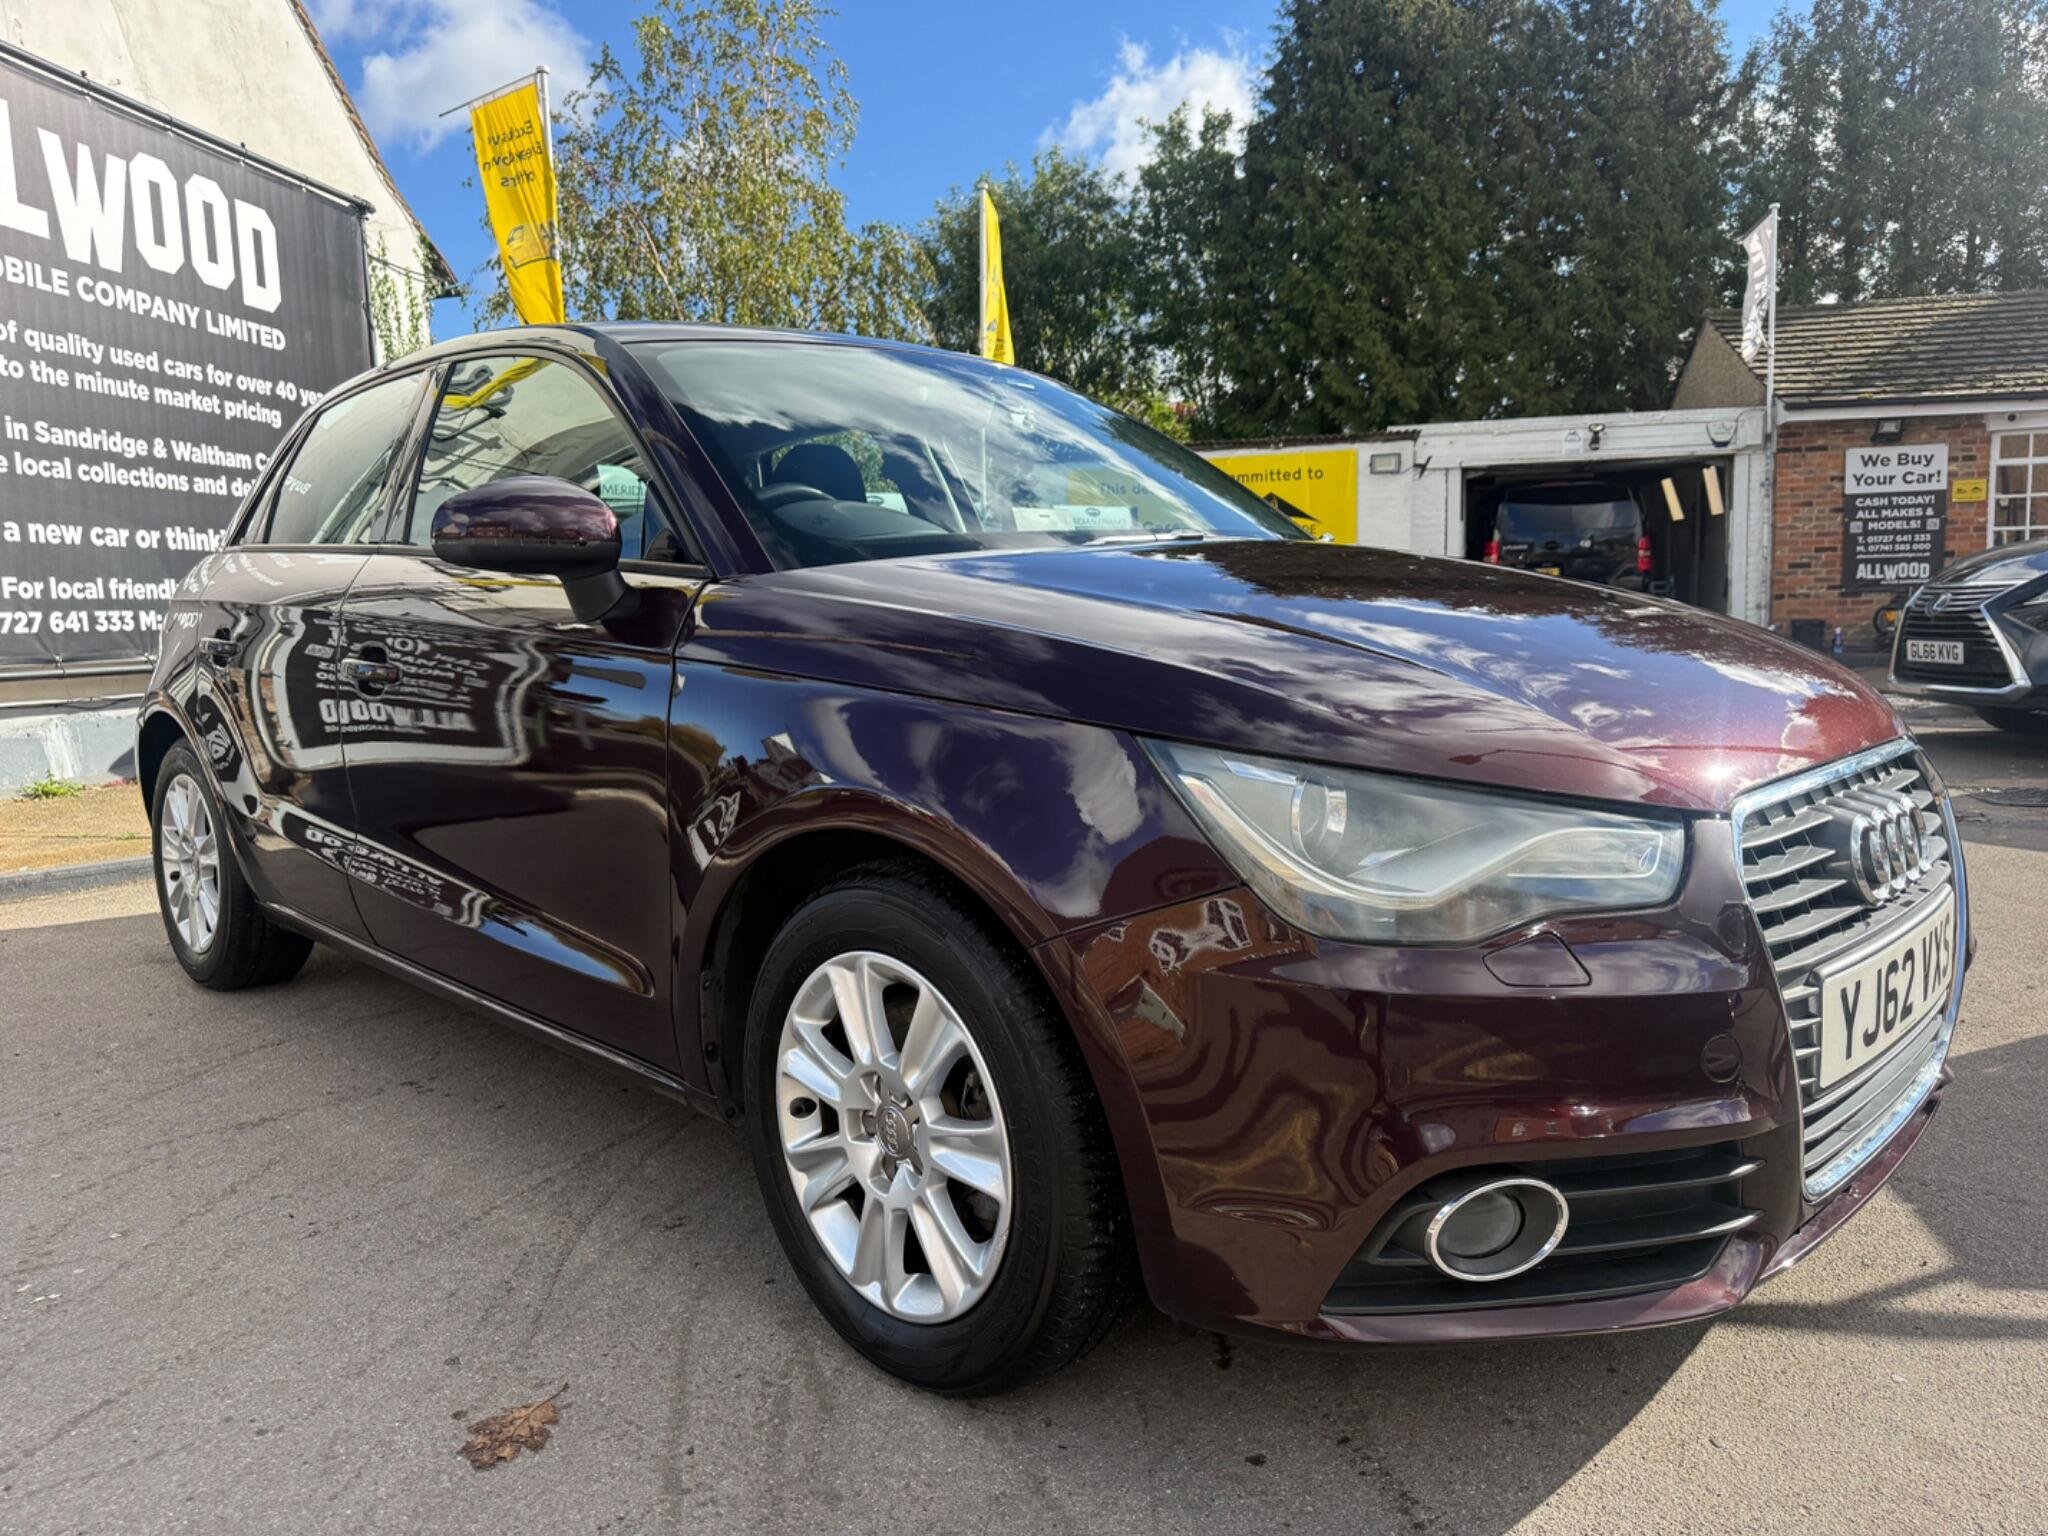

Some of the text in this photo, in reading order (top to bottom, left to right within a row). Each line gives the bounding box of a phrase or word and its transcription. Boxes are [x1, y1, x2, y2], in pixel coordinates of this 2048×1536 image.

[0, 254, 286, 351] BILE COMPANY LIMITED
[24, 328, 104, 365] quality
[109, 346, 160, 373] used
[163, 358, 203, 382] cars
[206, 364, 233, 388] for
[236, 374, 272, 396] over
[275, 380, 298, 401] 40
[0, 354, 282, 429] to the minute market pricing
[4, 415, 29, 441] in
[34, 420, 149, 459] Sandridge
[152, 437, 168, 459] &
[170, 439, 252, 470] Waltham
[1860, 452, 1934, 468] We Buy
[14, 451, 72, 480] local
[77, 461, 190, 493] collections
[193, 474, 228, 497] and
[1308, 467, 1324, 480] to
[1852, 470, 1942, 487] Your Car!
[1855, 494, 1936, 507] CASH TODAY!
[1855, 506, 1935, 519] ALL MAKES &
[3, 521, 21, 542] a
[28, 521, 82, 546] new
[90, 526, 130, 548] car
[135, 529, 161, 549] or
[1868, 520, 1922, 531] MODELS!
[1856, 562, 1930, 580] ALLWOOD
[1, 576, 44, 600] For
[49, 576, 104, 600] local
[49, 610, 89, 634] 641
[94, 610, 135, 632] 333
[1911, 643, 1959, 661] GL66 KVG
[1840, 912, 1950, 1061] YJ62 VXS
